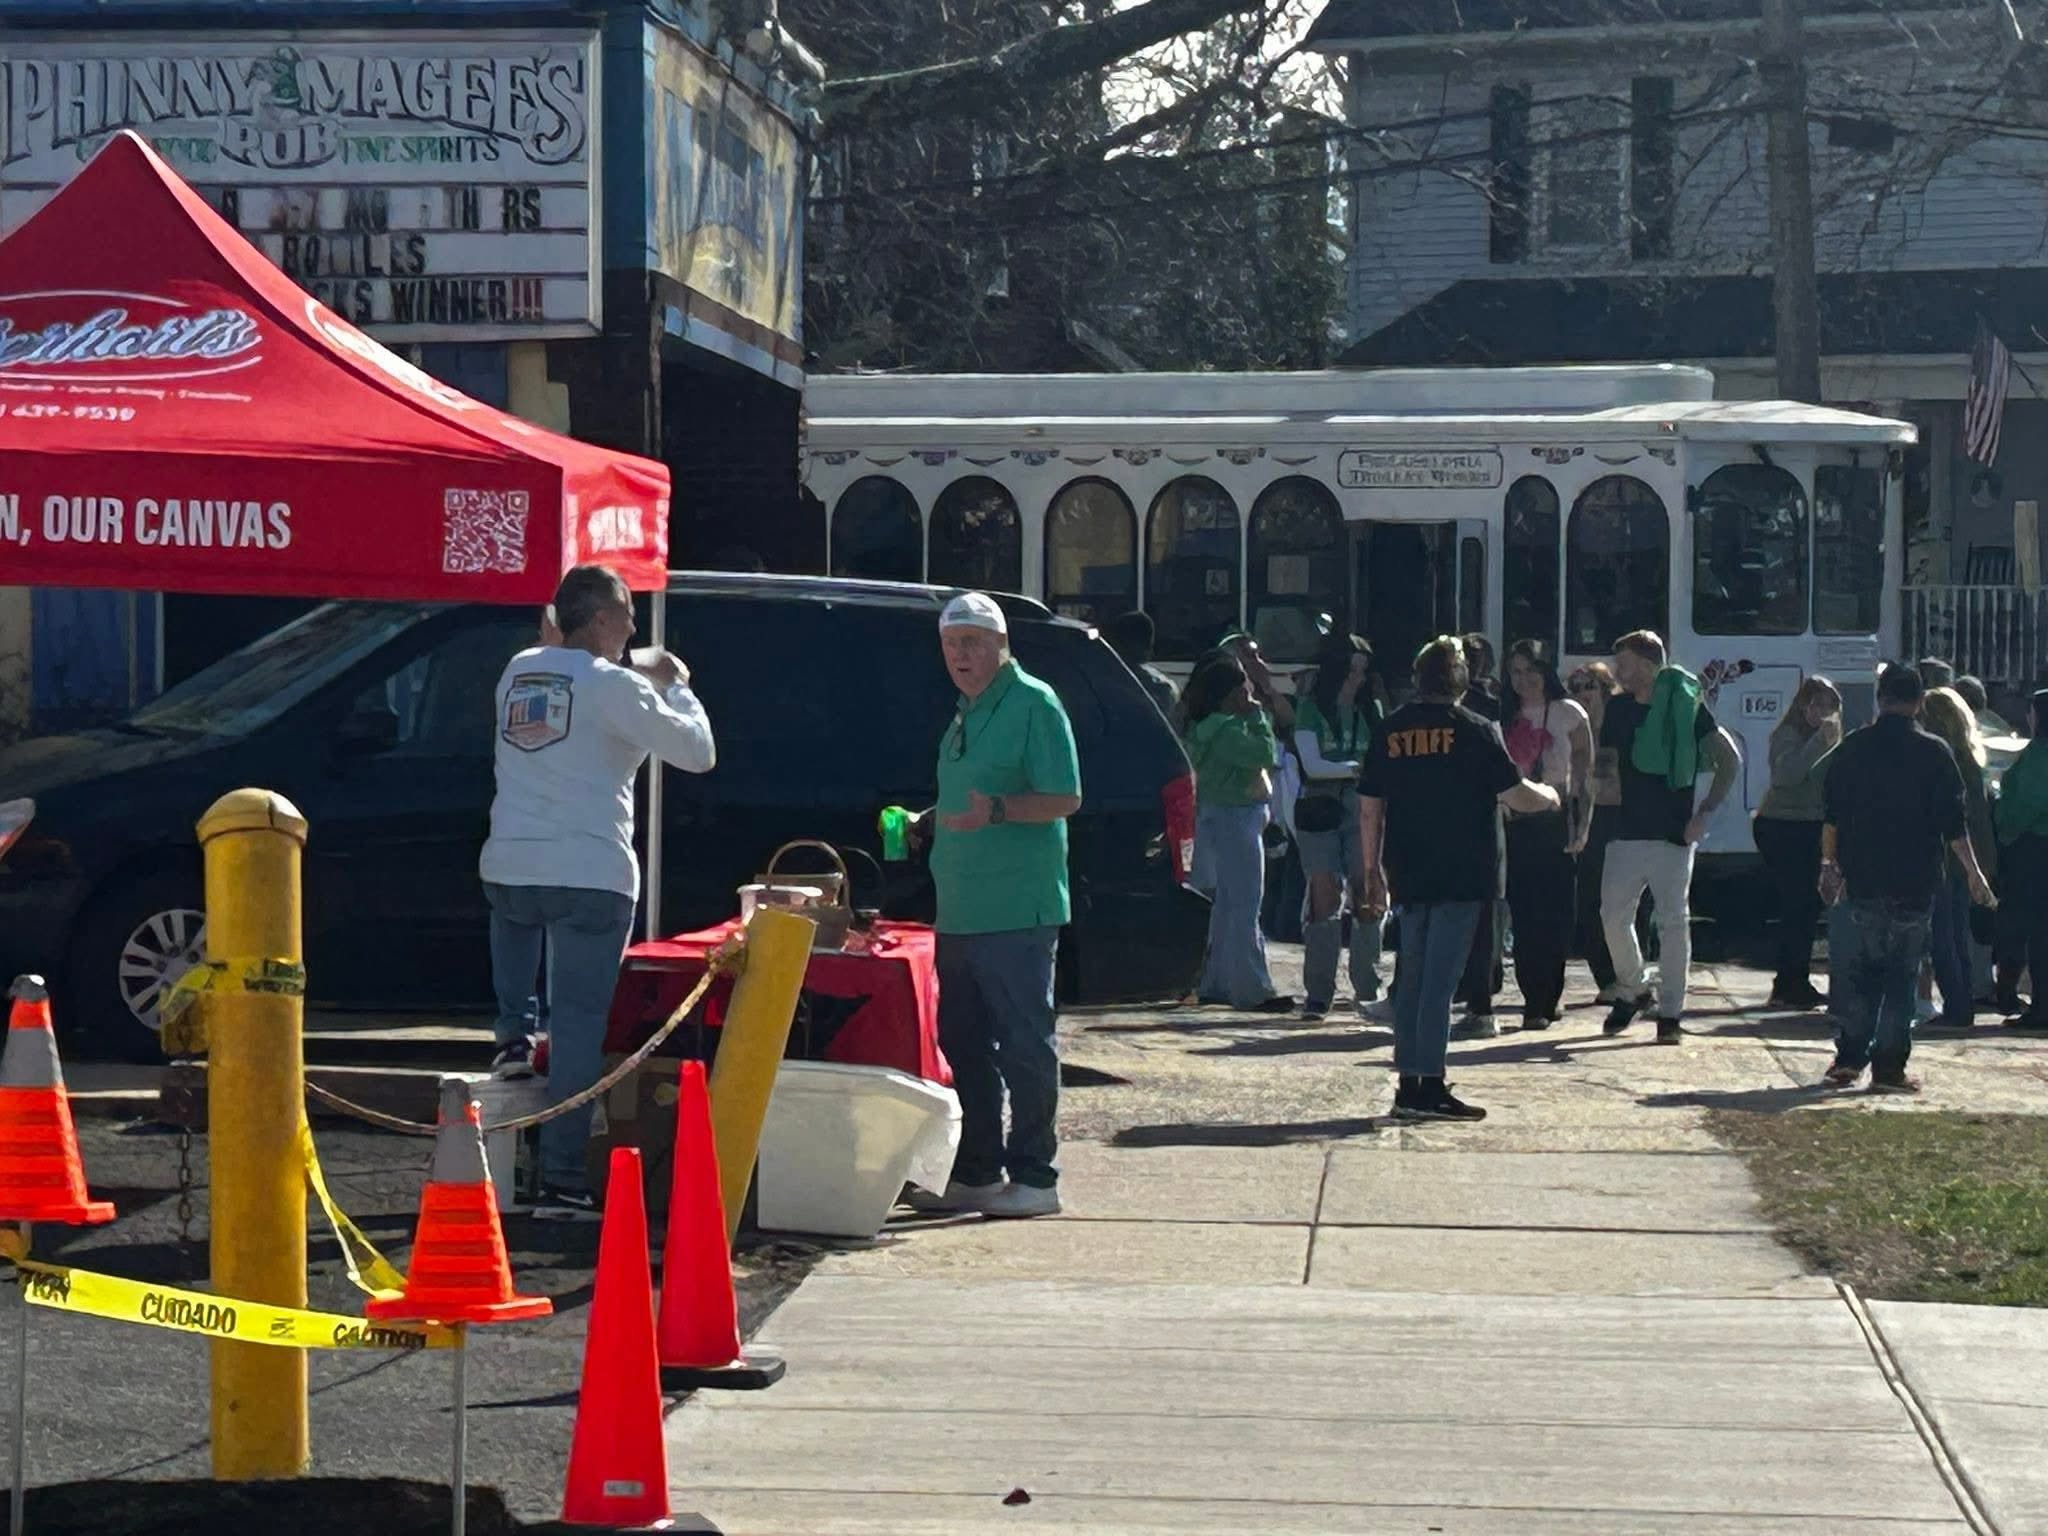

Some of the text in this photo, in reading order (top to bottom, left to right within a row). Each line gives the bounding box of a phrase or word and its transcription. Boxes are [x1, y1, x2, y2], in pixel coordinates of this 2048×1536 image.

[1, 52, 587, 167] PHINNY MAGEE'S
[218, 117, 338, 170] PUB
[400, 136, 500, 163] SPIRITS
[42, 494, 124, 545] OUR
[134, 497, 292, 550] CANVAS
[1386, 727, 1456, 759] STAFF
[141, 1292, 237, 1334] CUIDADO
